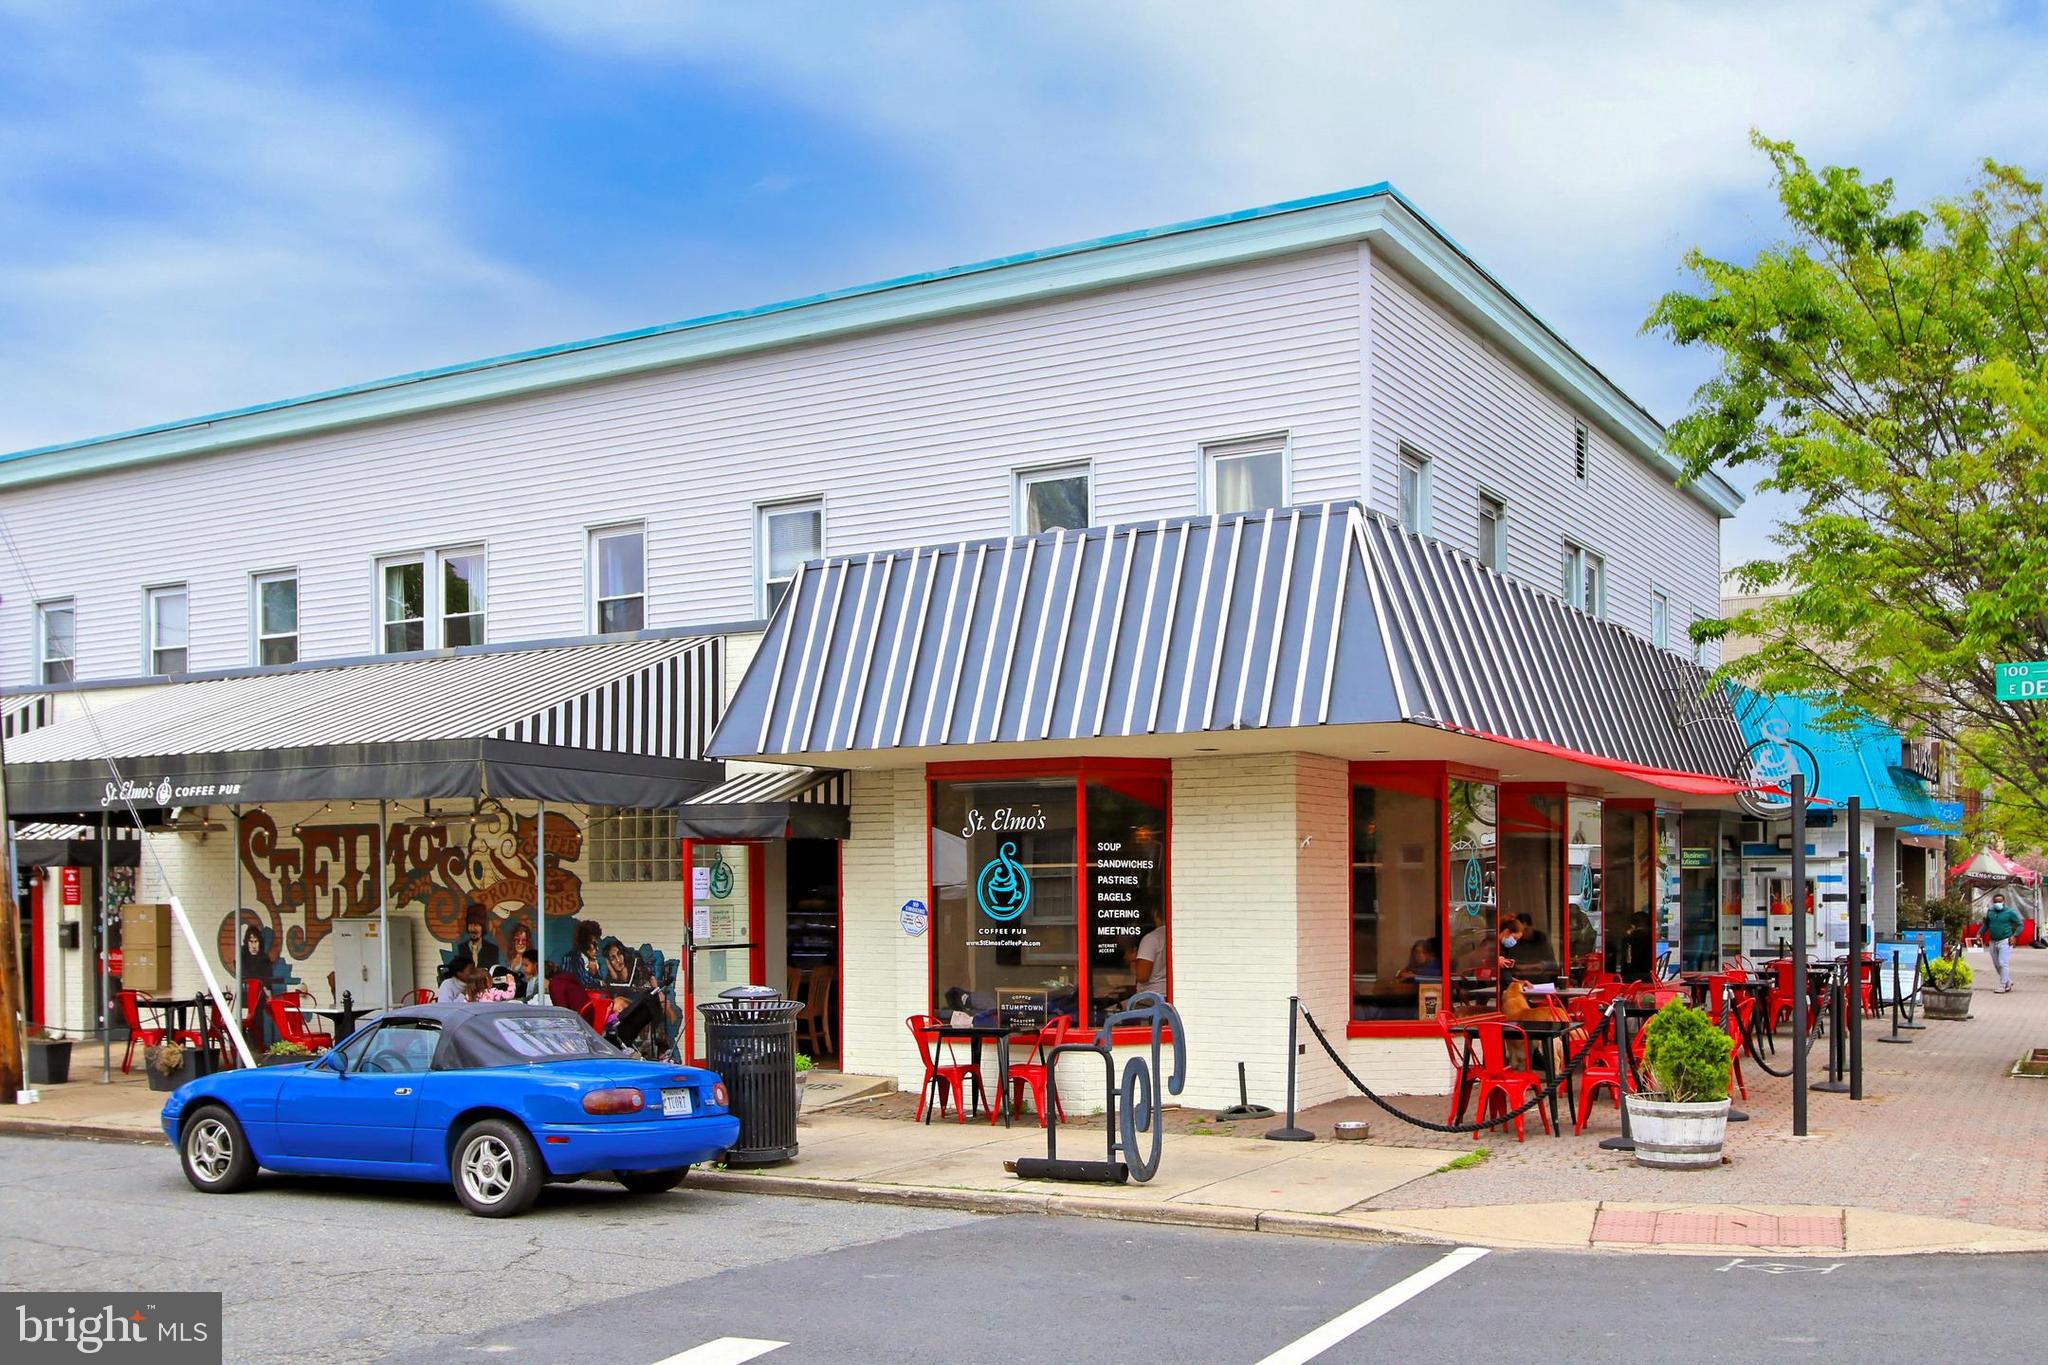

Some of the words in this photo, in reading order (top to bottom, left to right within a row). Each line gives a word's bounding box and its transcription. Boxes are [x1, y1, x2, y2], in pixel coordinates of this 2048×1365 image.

[2003, 666, 2029, 677] 100
[2009, 684, 2017, 695] E
[101, 782, 118, 806] St.
[119, 779, 155, 800] Elmo's
[175, 785, 216, 797] COFFEE
[218, 784, 241, 795] PUB
[962, 809, 987, 838] St.
[991, 807, 1047, 831] Elmo's
[1097, 842, 1121, 851] SOUP
[1097, 859, 1154, 869] SANDWICHES
[1097, 875, 1138, 885] PASTRIES
[479, 880, 578, 913] PROVISONS
[1097, 892, 1132, 901] BAGELS
[1097, 909, 1140, 919] CATERING
[1097, 926, 1141, 936] MEETINGS
